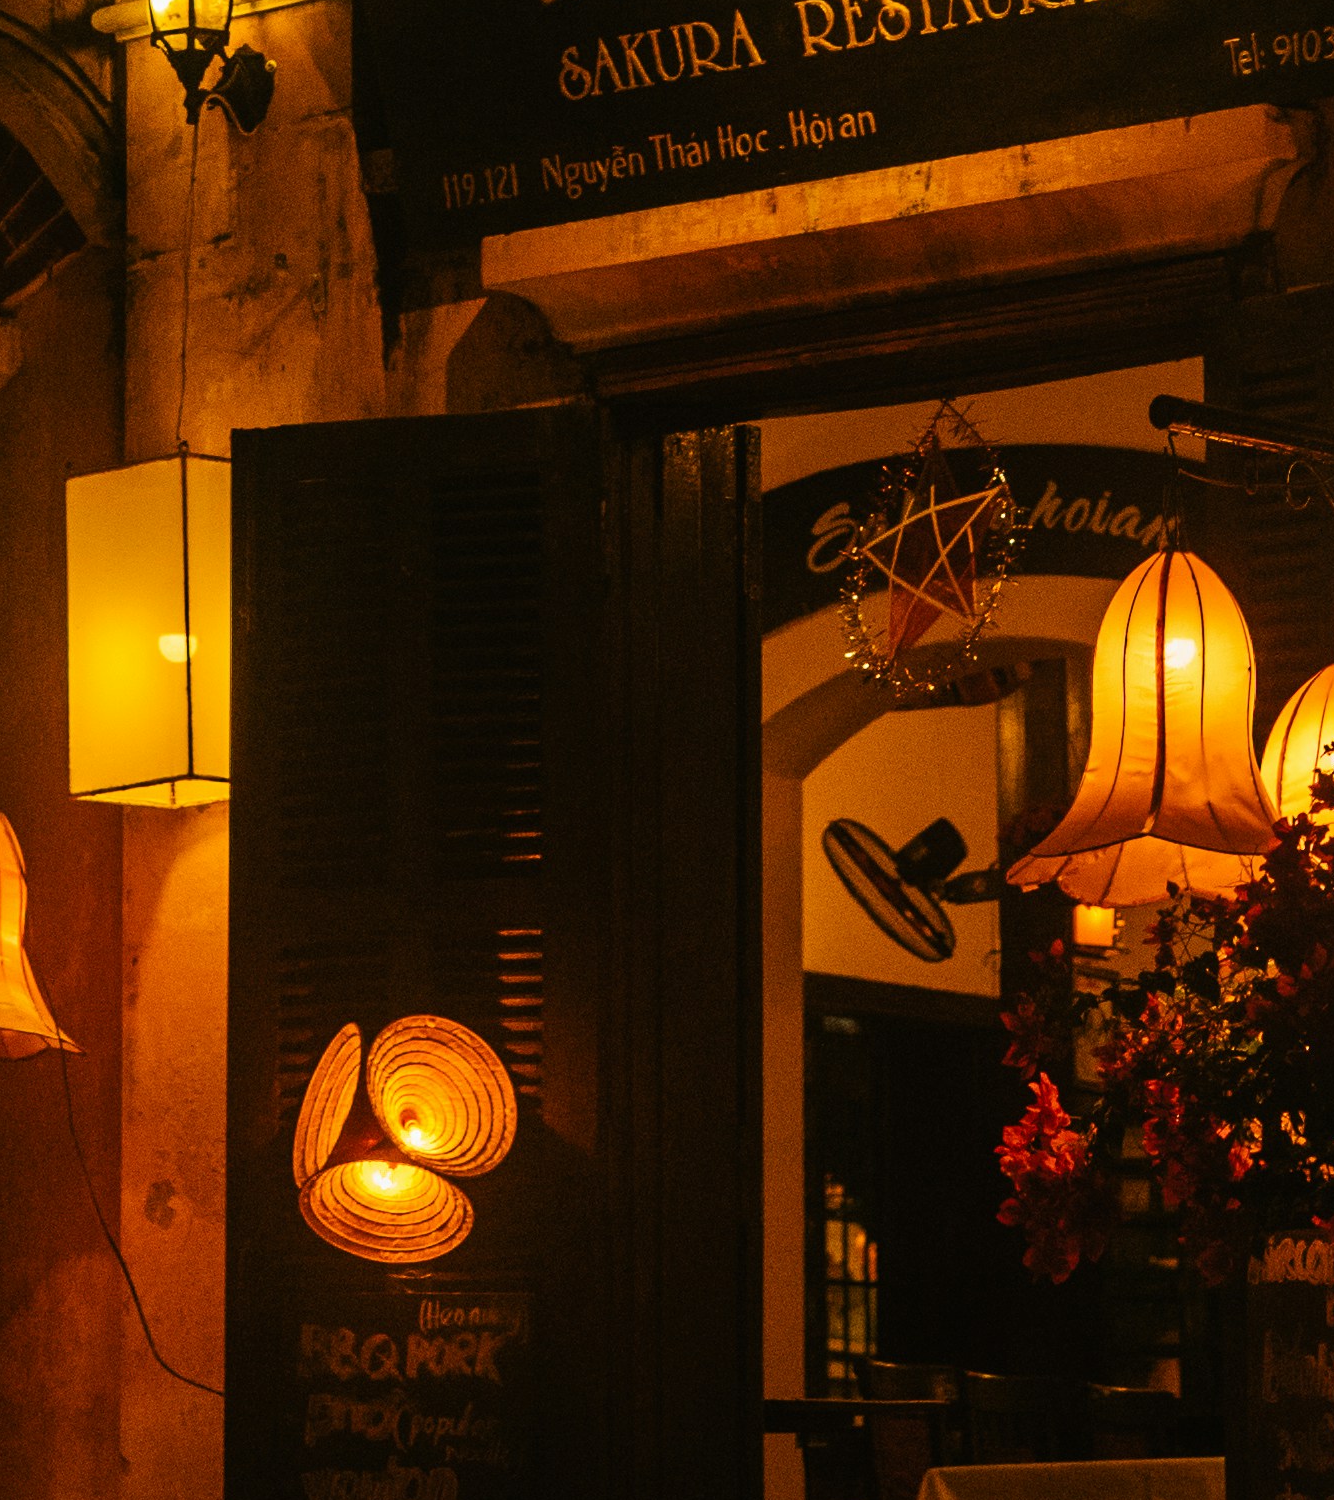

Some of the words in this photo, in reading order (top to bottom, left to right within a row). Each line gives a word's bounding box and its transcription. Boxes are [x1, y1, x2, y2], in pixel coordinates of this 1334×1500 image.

[559, 8, 767, 101] SAKURA
[1223, 32, 1266, 76] Tel:
[541, 145, 646, 200] Nguyễn
[648, 128, 711, 173] Thái
[406, 1331, 505, 1387] PORK
